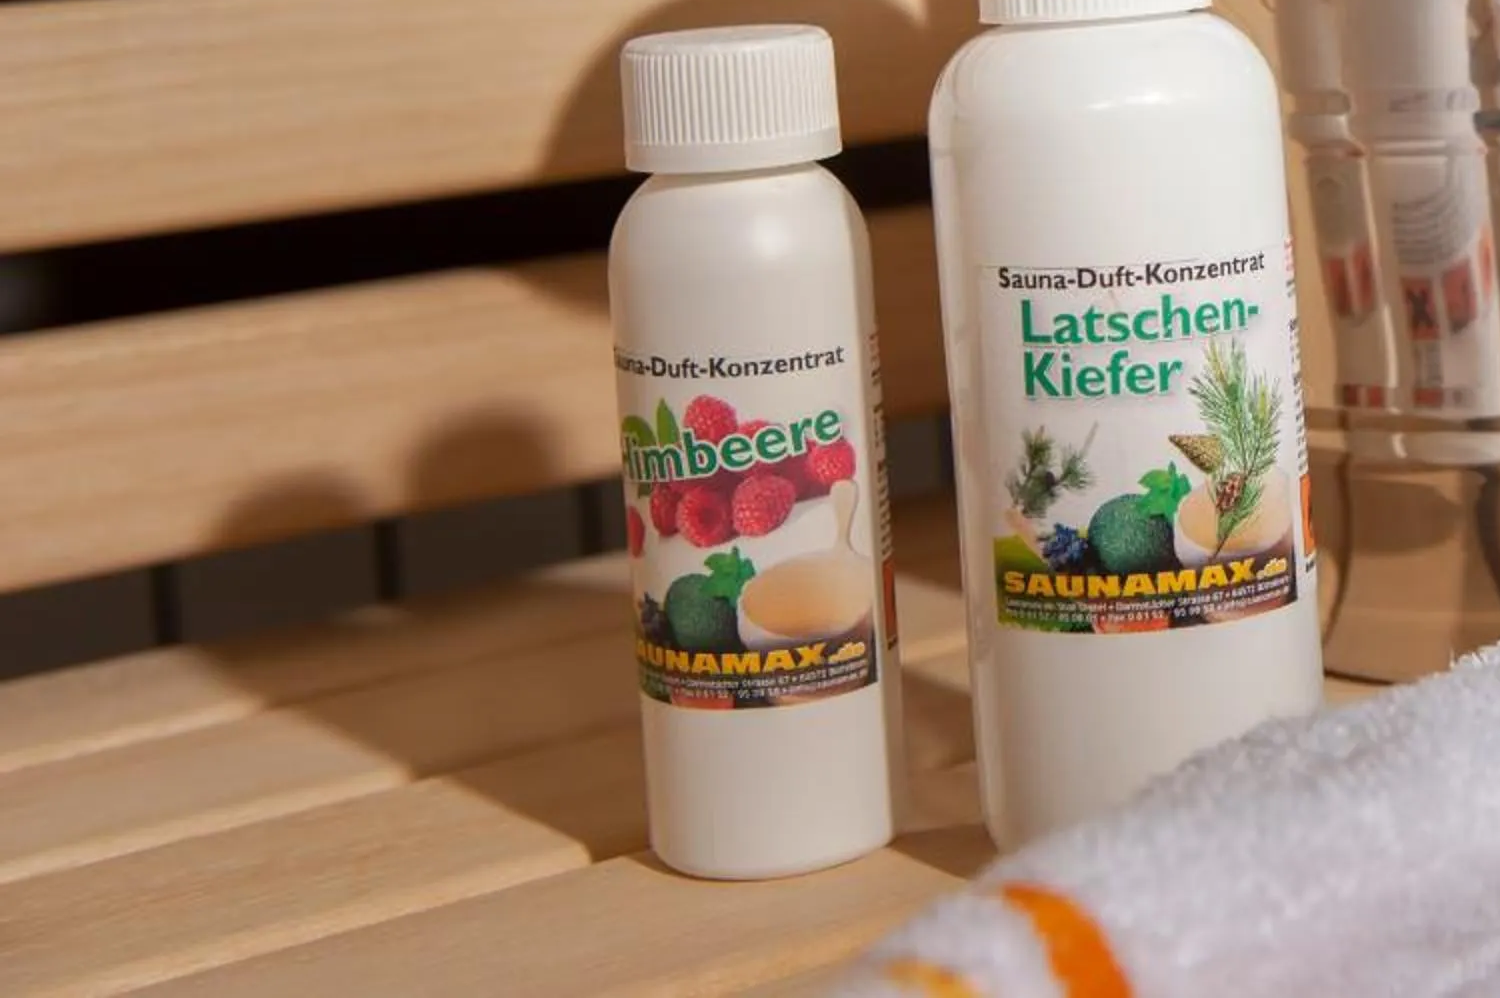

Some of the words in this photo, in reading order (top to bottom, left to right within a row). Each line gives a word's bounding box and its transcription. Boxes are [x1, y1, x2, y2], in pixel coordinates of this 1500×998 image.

[999, 252, 1264, 289] Sauna-Duft-Konzentrat
[1020, 294, 1259, 345] Latschen-
[1023, 350, 1182, 397] Kiefer
